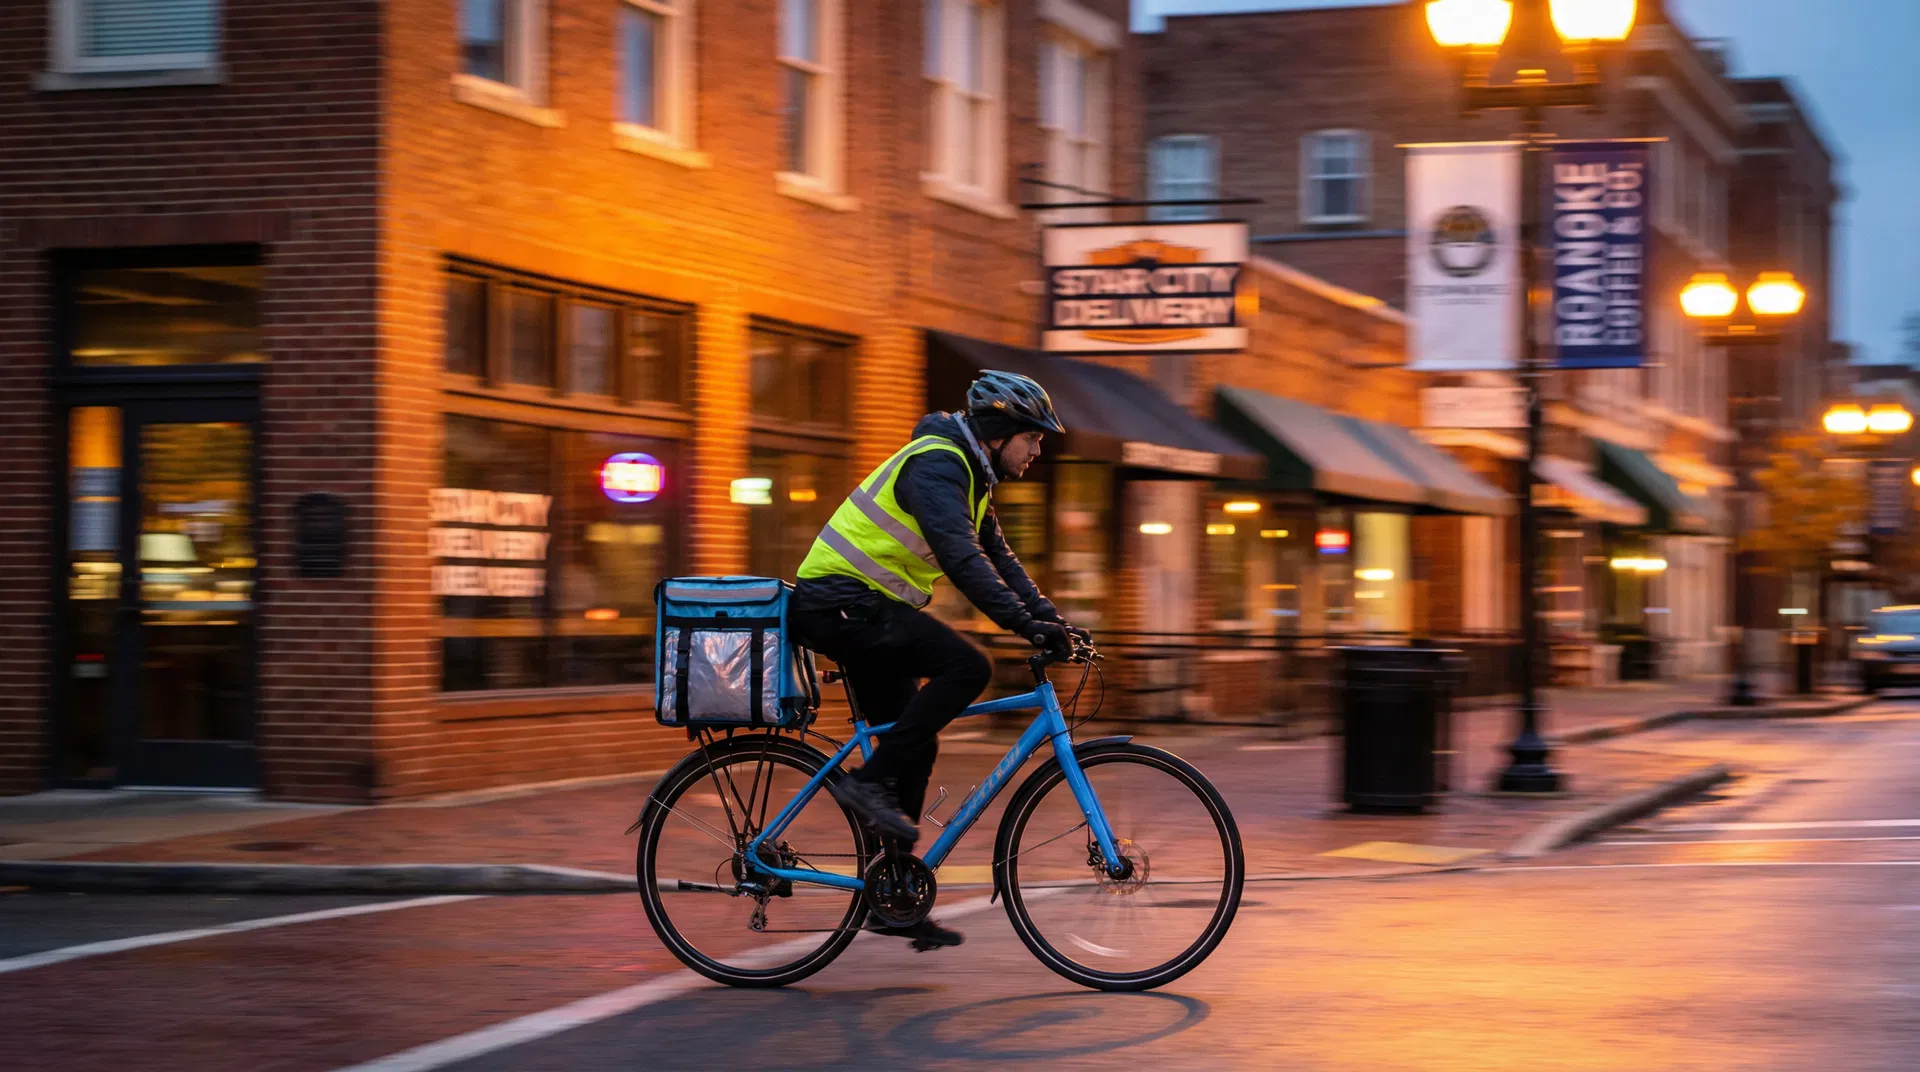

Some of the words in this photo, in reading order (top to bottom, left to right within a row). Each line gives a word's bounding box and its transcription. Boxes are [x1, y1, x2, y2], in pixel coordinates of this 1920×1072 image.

[1608, 216, 1642, 235] &
[1553, 163, 1607, 346] ROANOKE
[1053, 269, 1149, 295] STAR
[1150, 266, 1240, 293] CITY
[1605, 243, 1643, 346] COFFEE
[1054, 297, 1236, 326] DELIVERY
